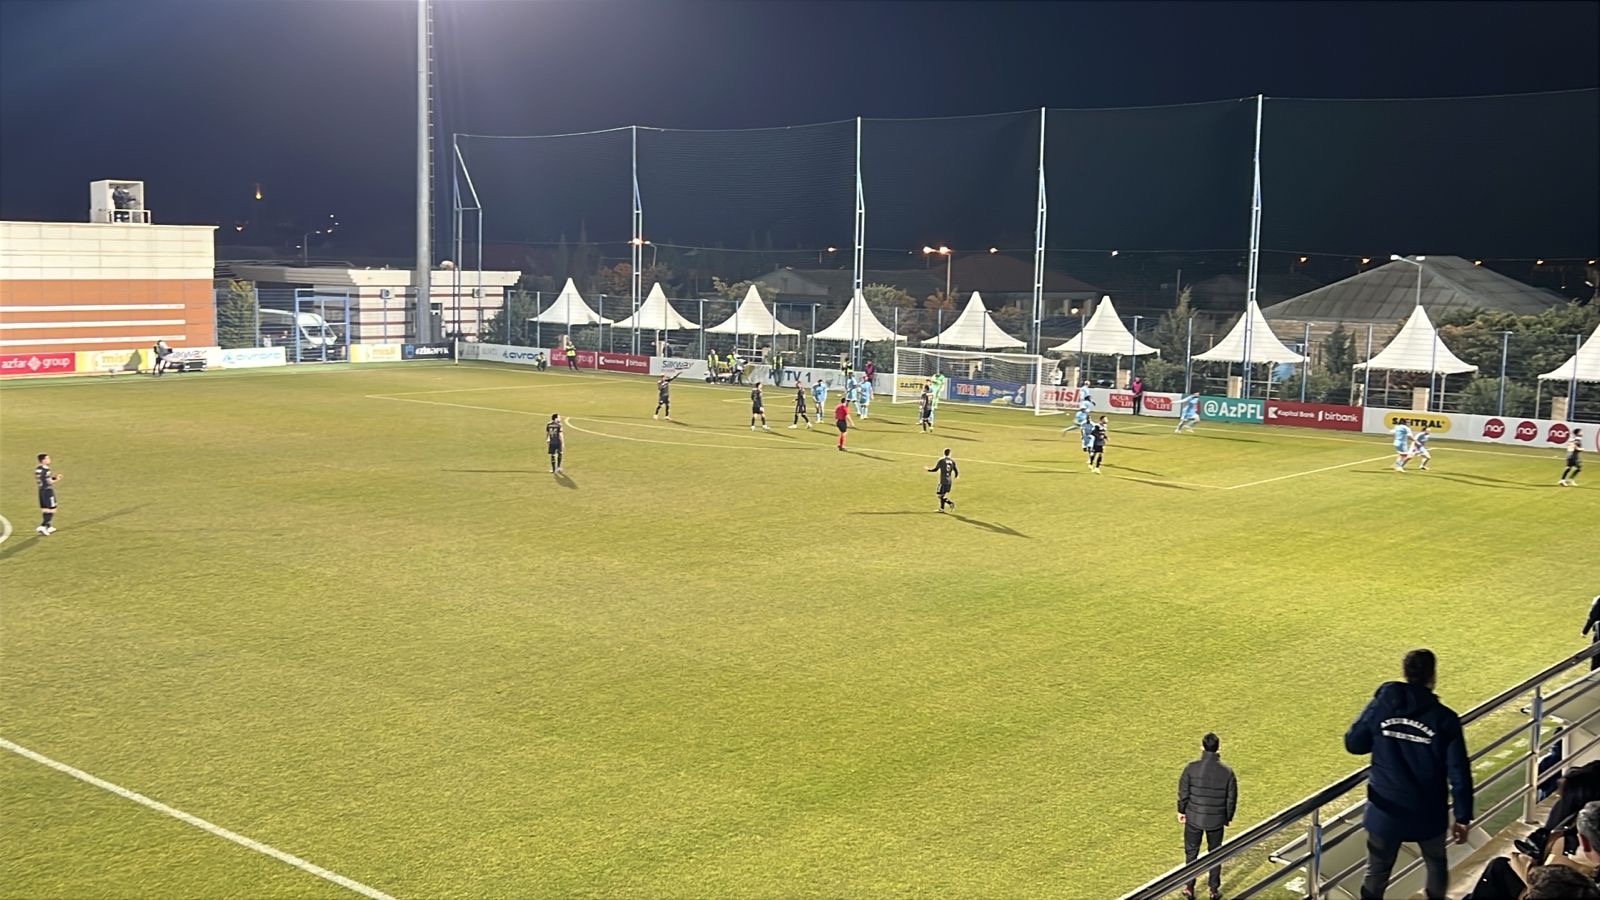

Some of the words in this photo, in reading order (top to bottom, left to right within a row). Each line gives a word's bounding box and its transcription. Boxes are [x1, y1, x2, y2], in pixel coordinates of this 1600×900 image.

[2, 358, 26, 369] azfar
[42, 357, 70, 369] group
[784, 370, 801, 381] TV
[805, 372, 811, 382] 1
[1204, 400, 1264, 419] @AzPFL
[1324, 411, 1358, 423] birbank
[1485, 424, 1504, 433] nar
[1518, 427, 1536, 435] nar
[1550, 430, 1569, 438] nar
